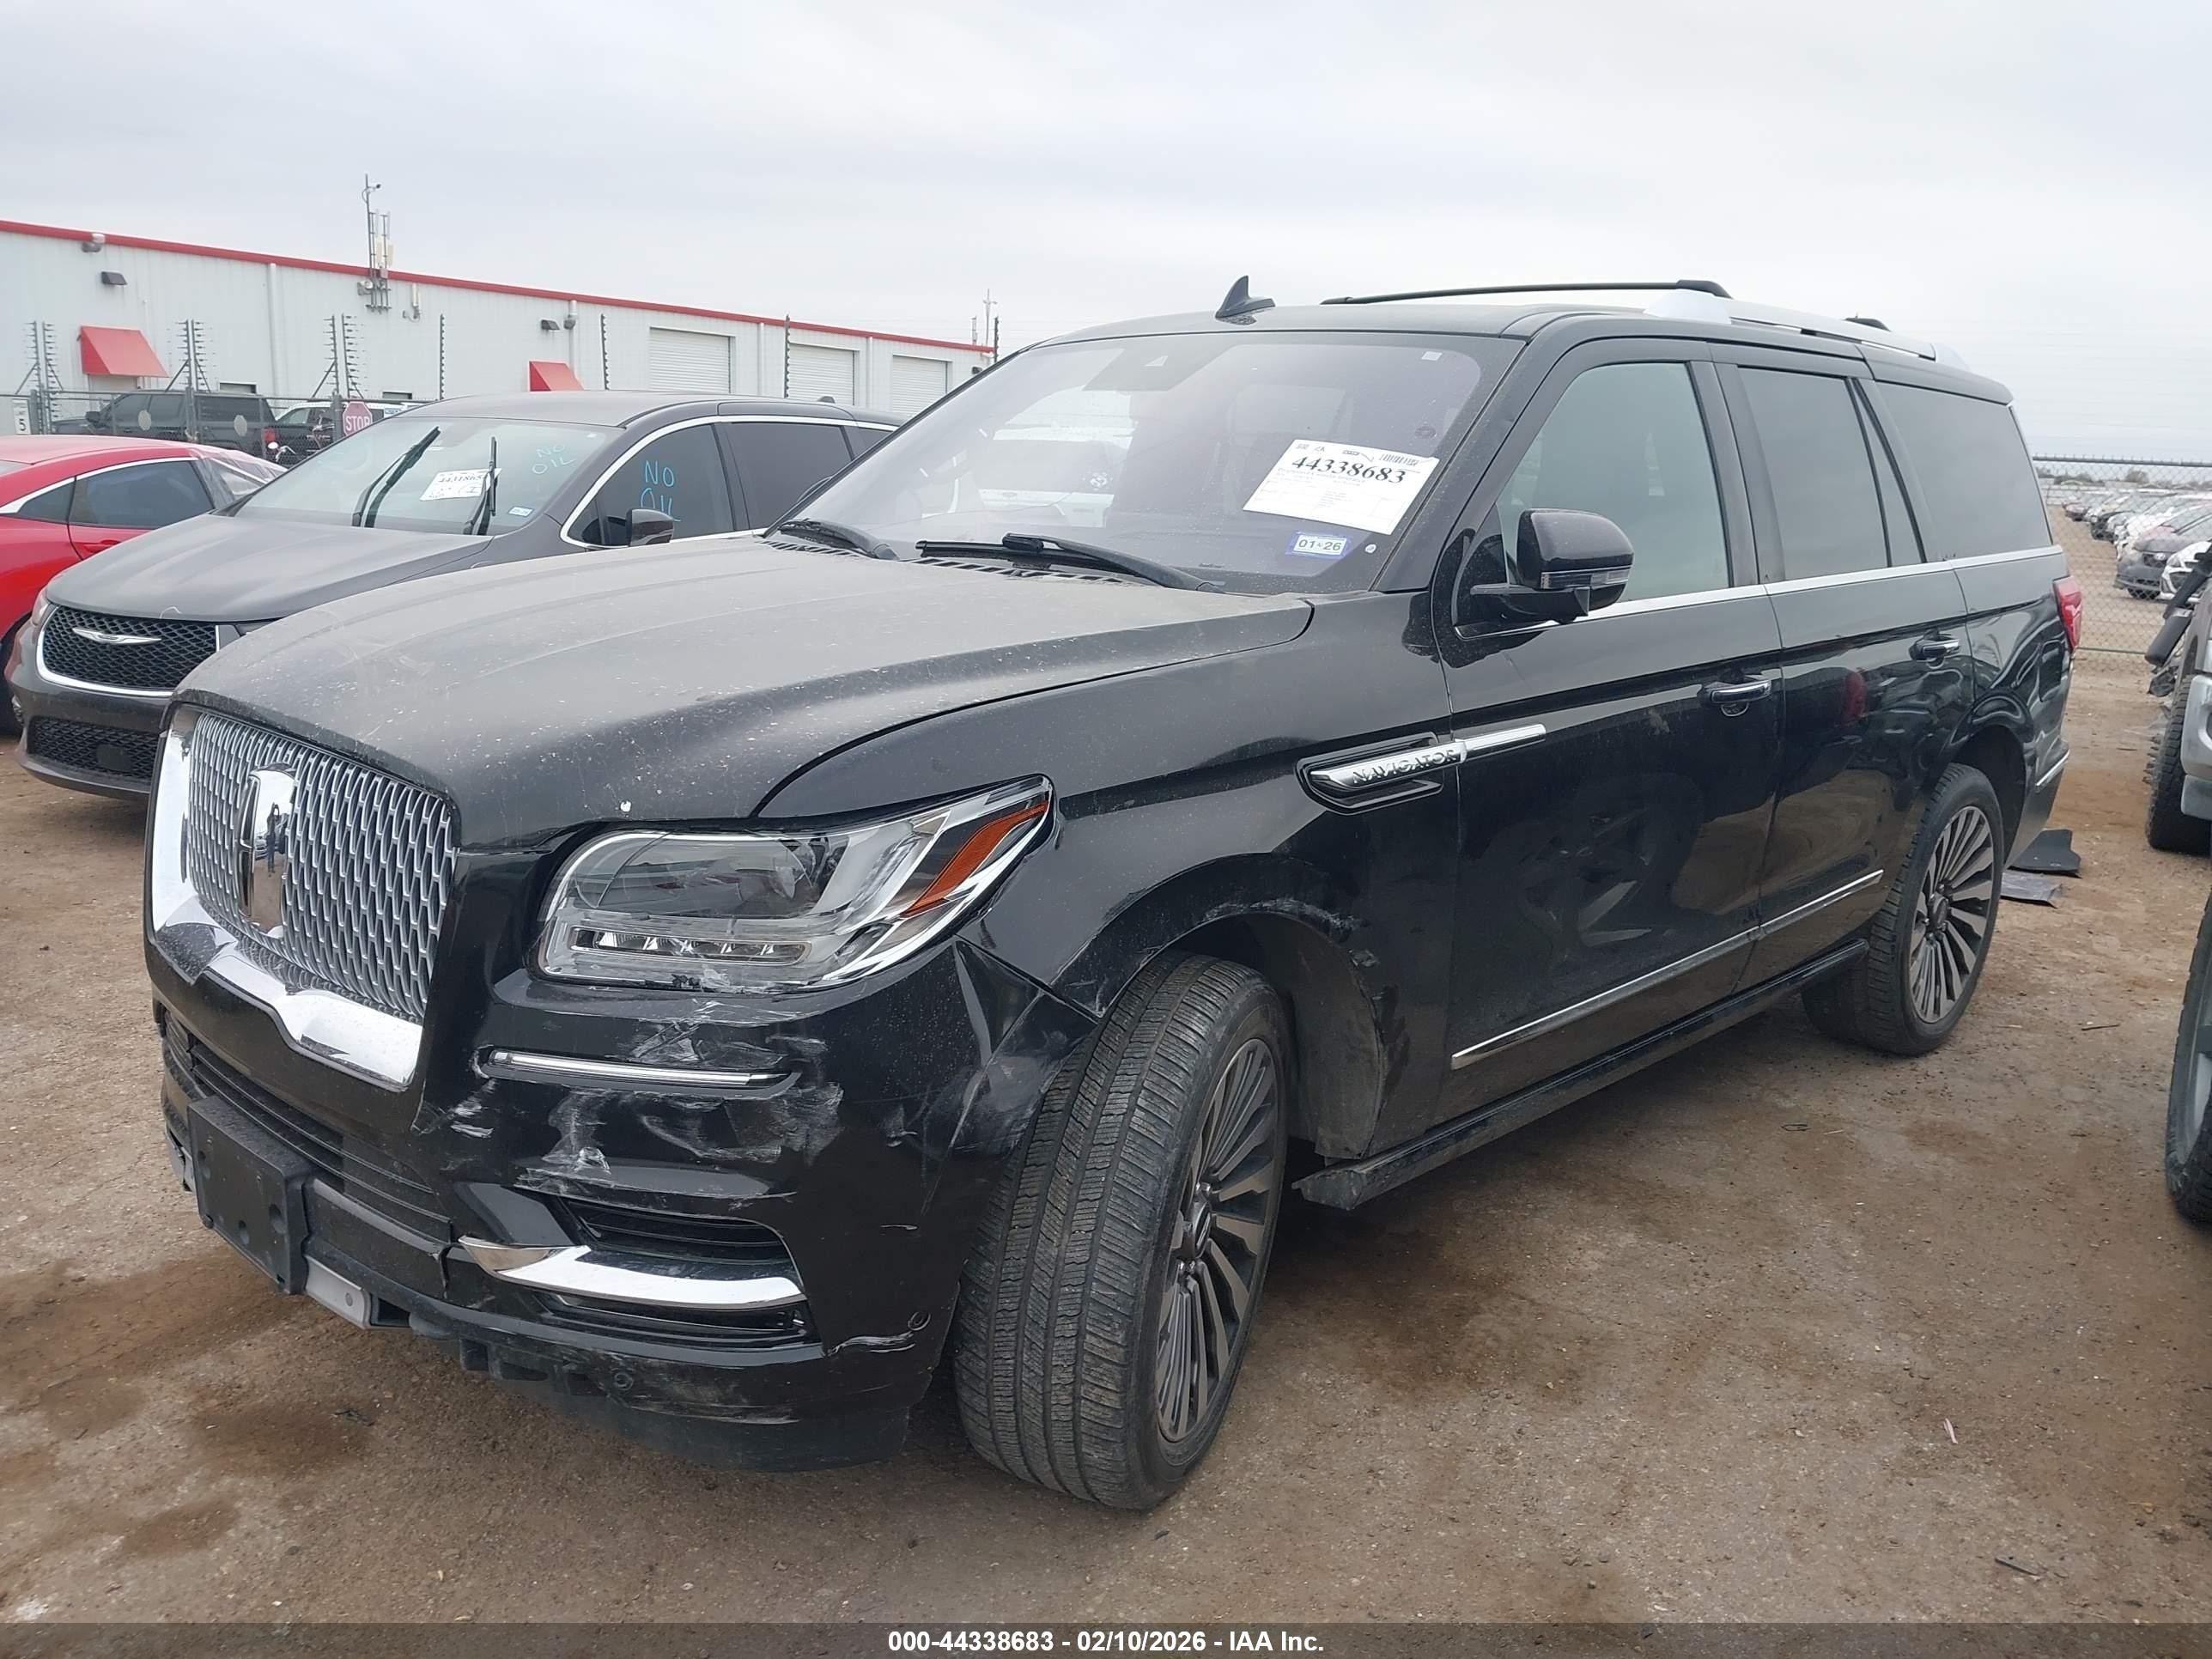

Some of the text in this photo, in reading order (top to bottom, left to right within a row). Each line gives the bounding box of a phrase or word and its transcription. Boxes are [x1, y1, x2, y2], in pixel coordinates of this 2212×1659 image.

[345, 416, 370, 432] STOP
[536, 443, 566, 458] NO
[532, 457, 576, 474] OIL
[645, 459, 675, 487] NO
[1291, 456, 1407, 483] 44338683
[1352, 750, 1457, 784] NAVIGATOR
